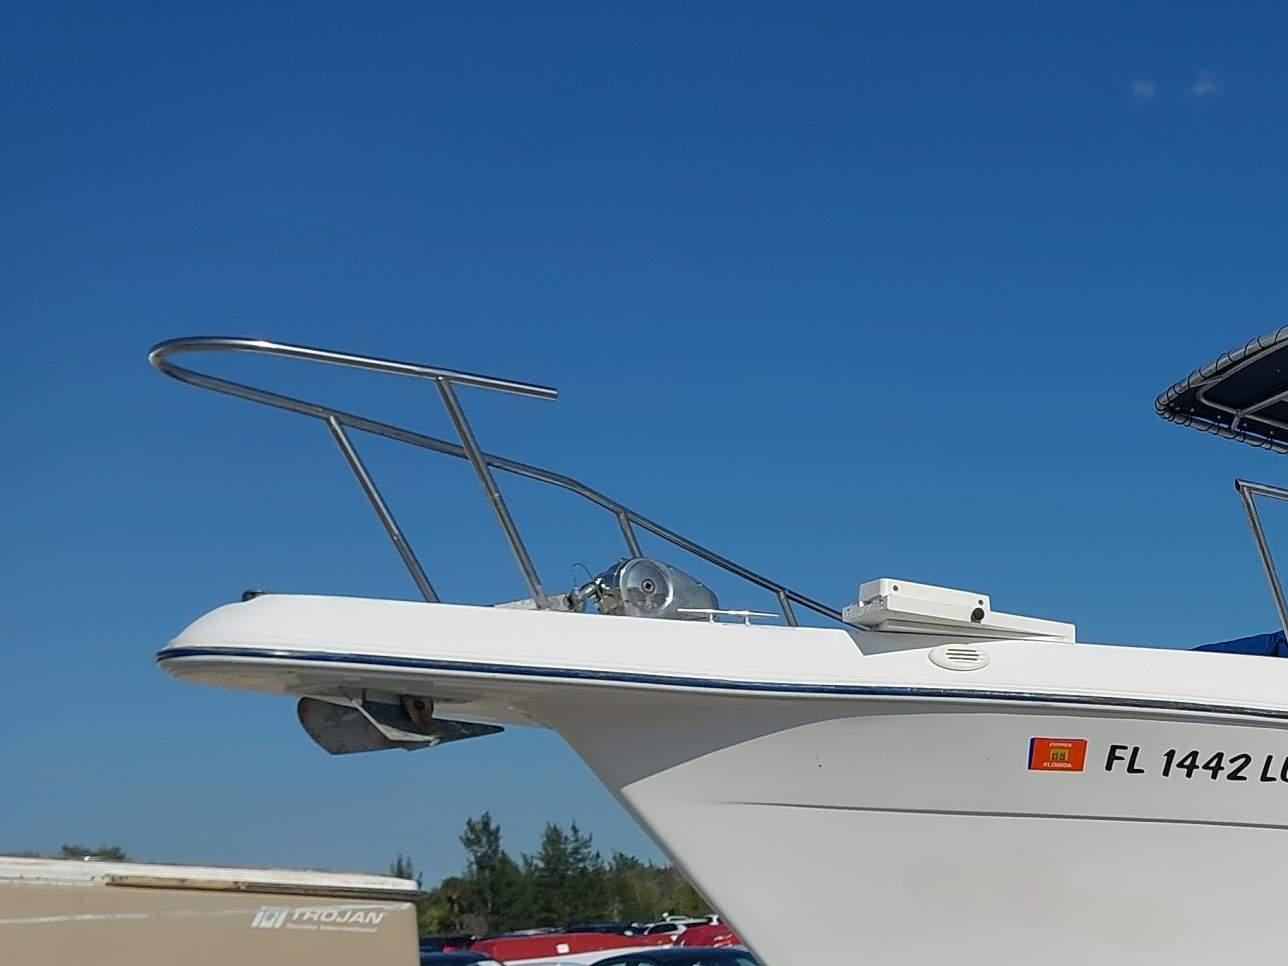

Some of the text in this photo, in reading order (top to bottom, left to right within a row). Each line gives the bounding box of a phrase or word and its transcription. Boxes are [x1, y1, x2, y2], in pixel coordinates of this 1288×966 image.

[1104, 744, 1145, 774] FL
[1162, 749, 1252, 781] 1442
[291, 908, 385, 925] TROJAN
